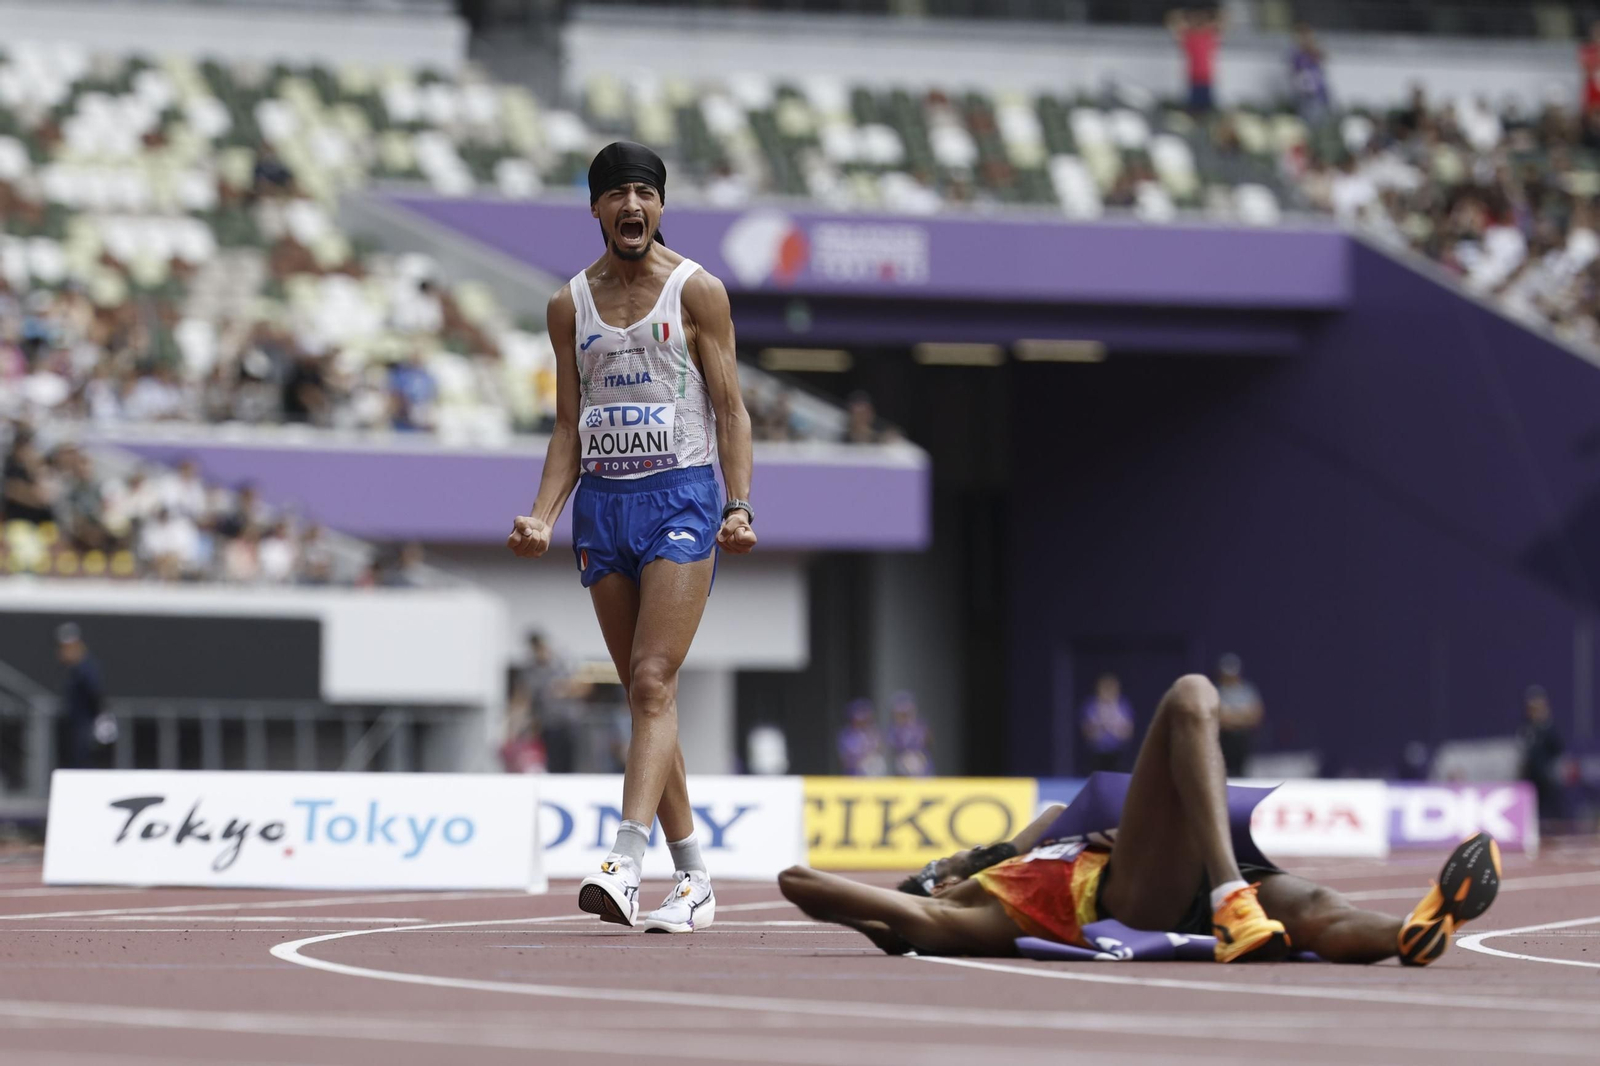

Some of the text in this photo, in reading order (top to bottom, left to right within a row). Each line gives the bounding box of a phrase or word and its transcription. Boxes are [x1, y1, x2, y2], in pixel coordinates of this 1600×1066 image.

[604, 371, 652, 388] ITALIA
[603, 406, 667, 427] TDK
[587, 430, 669, 456] AOUANI
[540, 799, 765, 851] ONY
